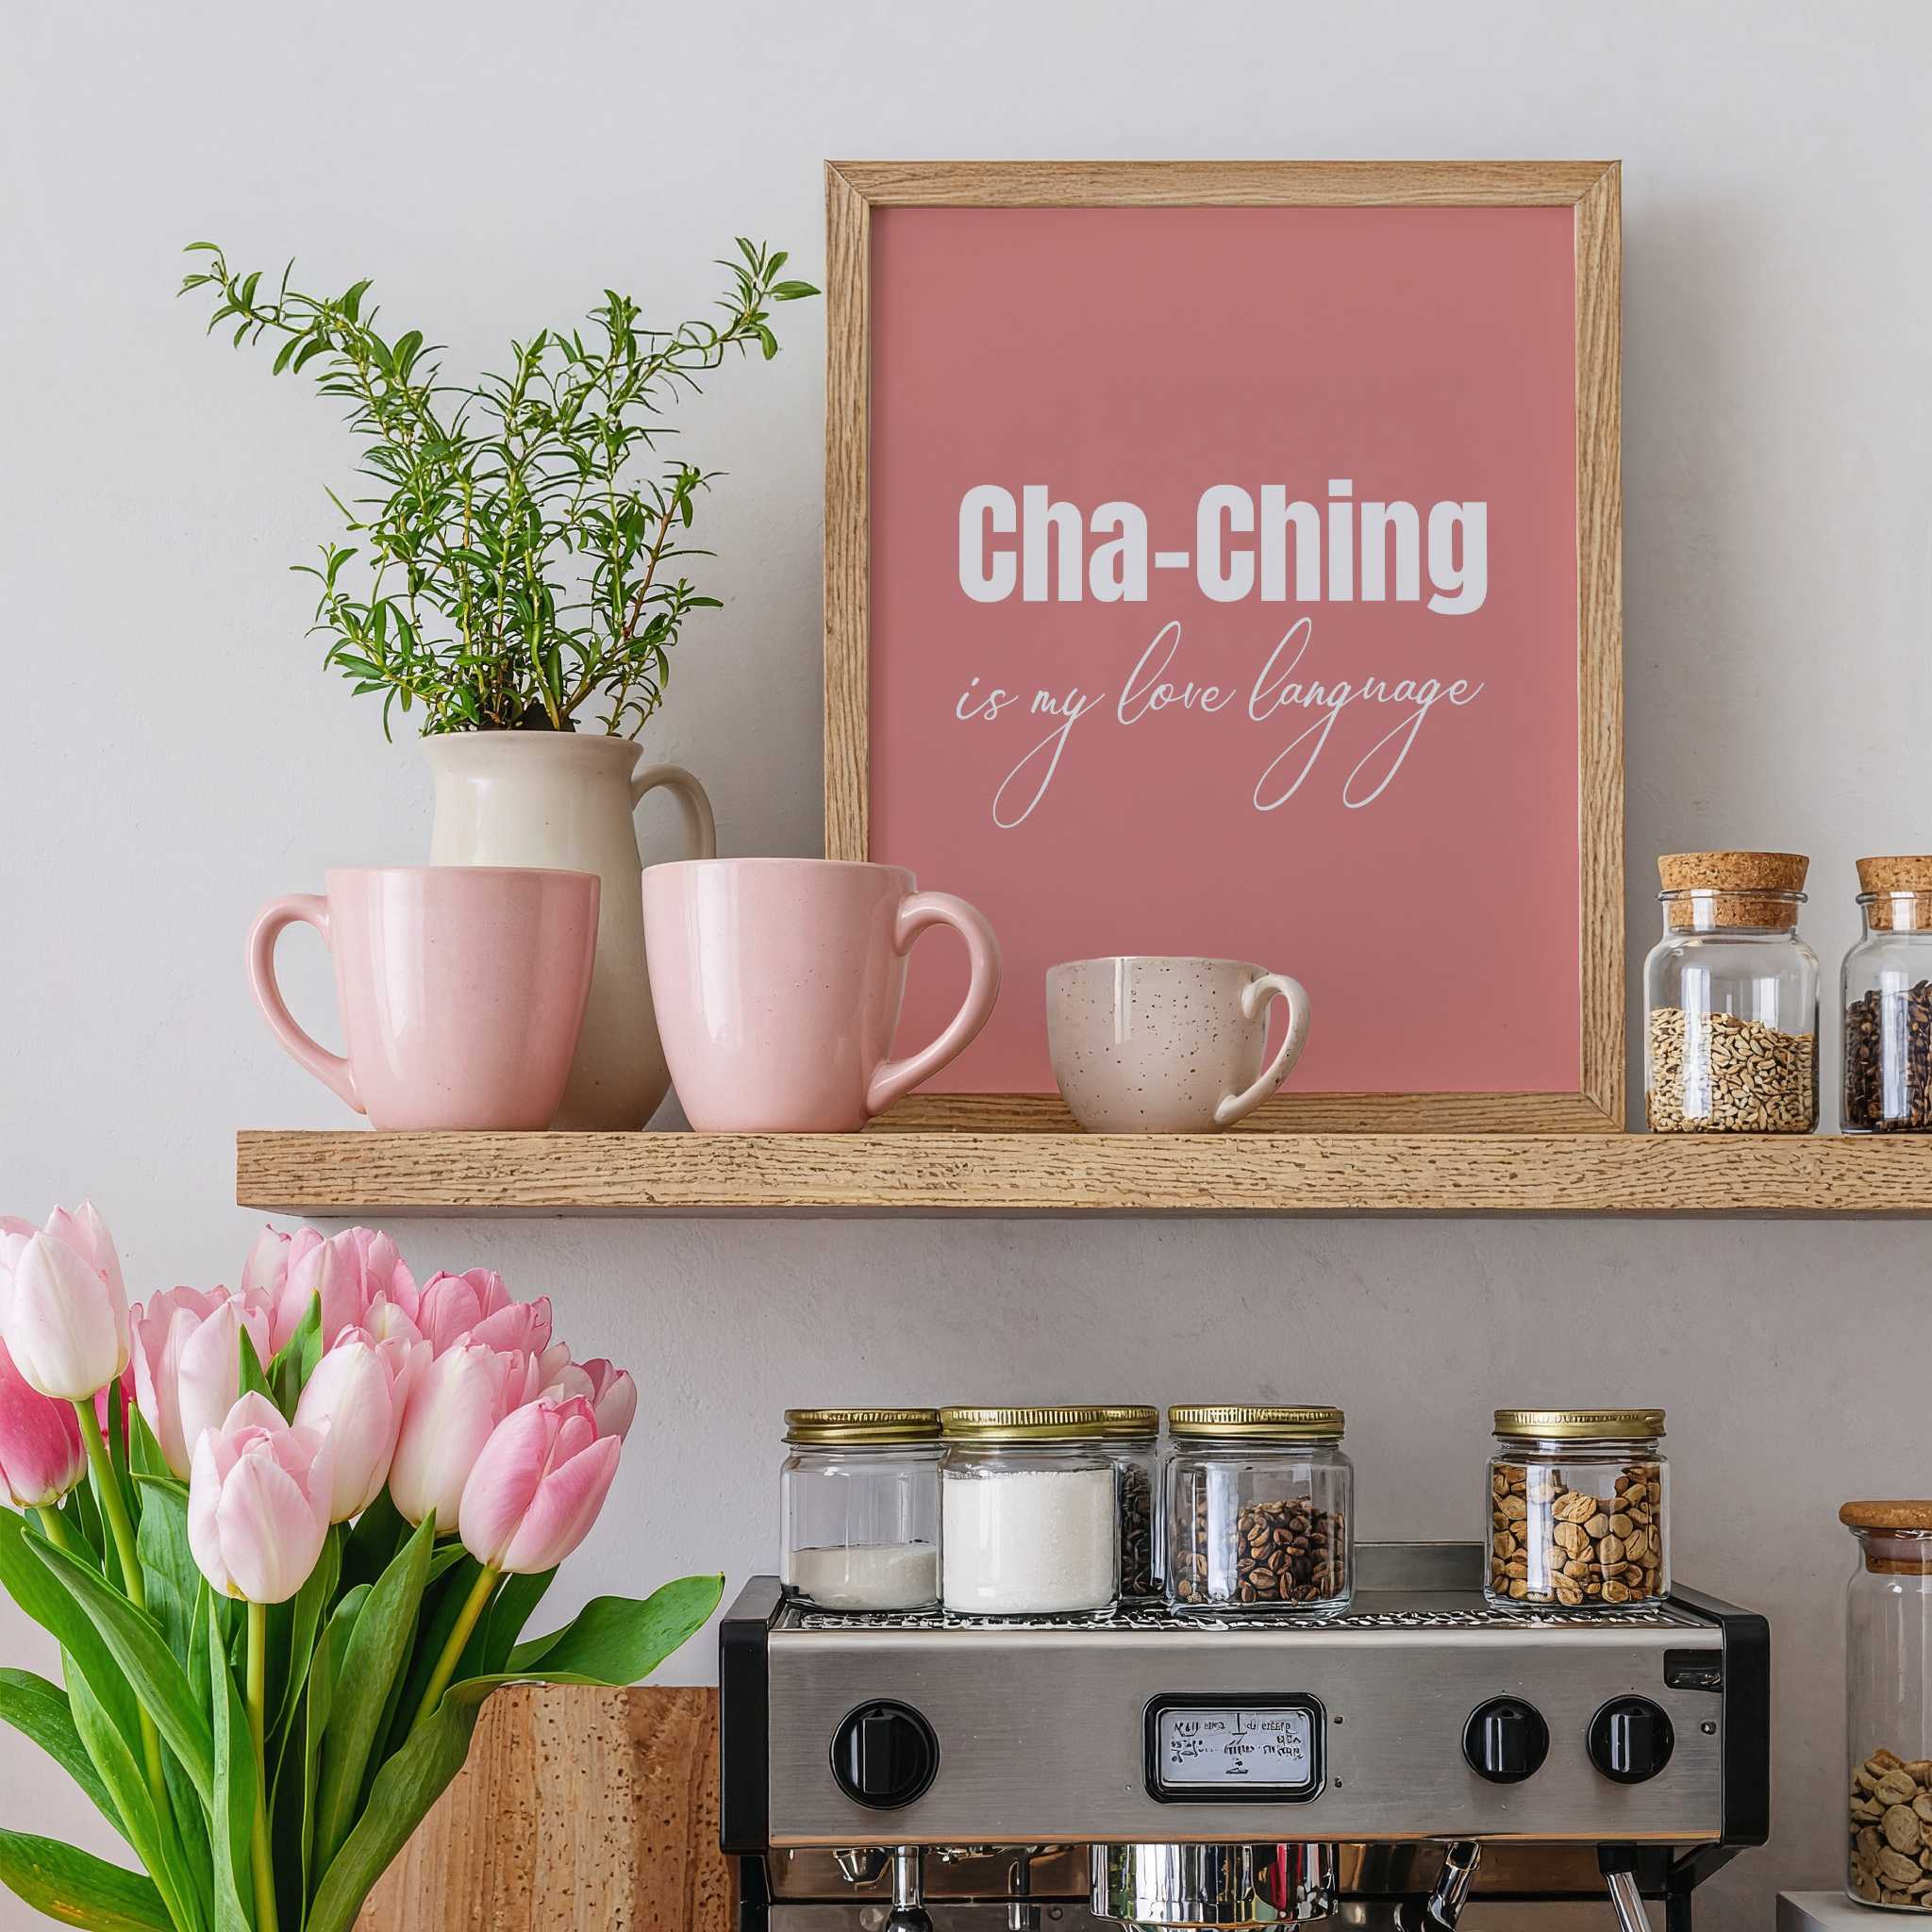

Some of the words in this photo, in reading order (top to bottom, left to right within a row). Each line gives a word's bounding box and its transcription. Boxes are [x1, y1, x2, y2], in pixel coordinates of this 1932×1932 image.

[958, 478, 1488, 615] Cha-Ching
[956, 676, 1019, 721] is
[992, 687, 1106, 828] my
[1117, 620, 1236, 725] love
[1248, 617, 1485, 811] language
